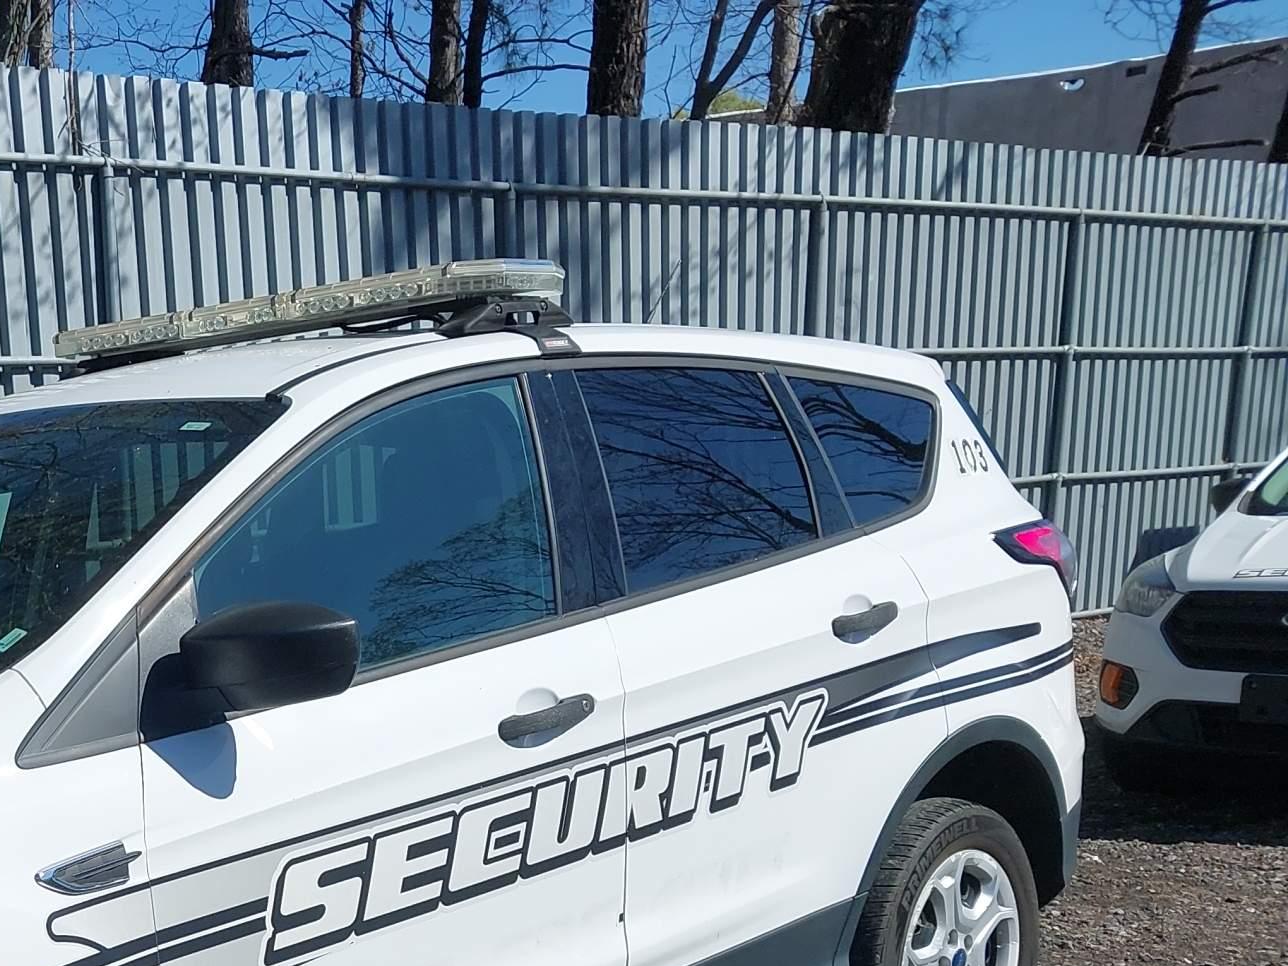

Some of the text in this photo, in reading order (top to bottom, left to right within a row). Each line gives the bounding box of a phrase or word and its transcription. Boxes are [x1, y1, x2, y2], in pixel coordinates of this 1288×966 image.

[951, 439, 989, 474] 103
[1232, 568, 1288, 579] SE
[264, 690, 828, 966] SECURITY
